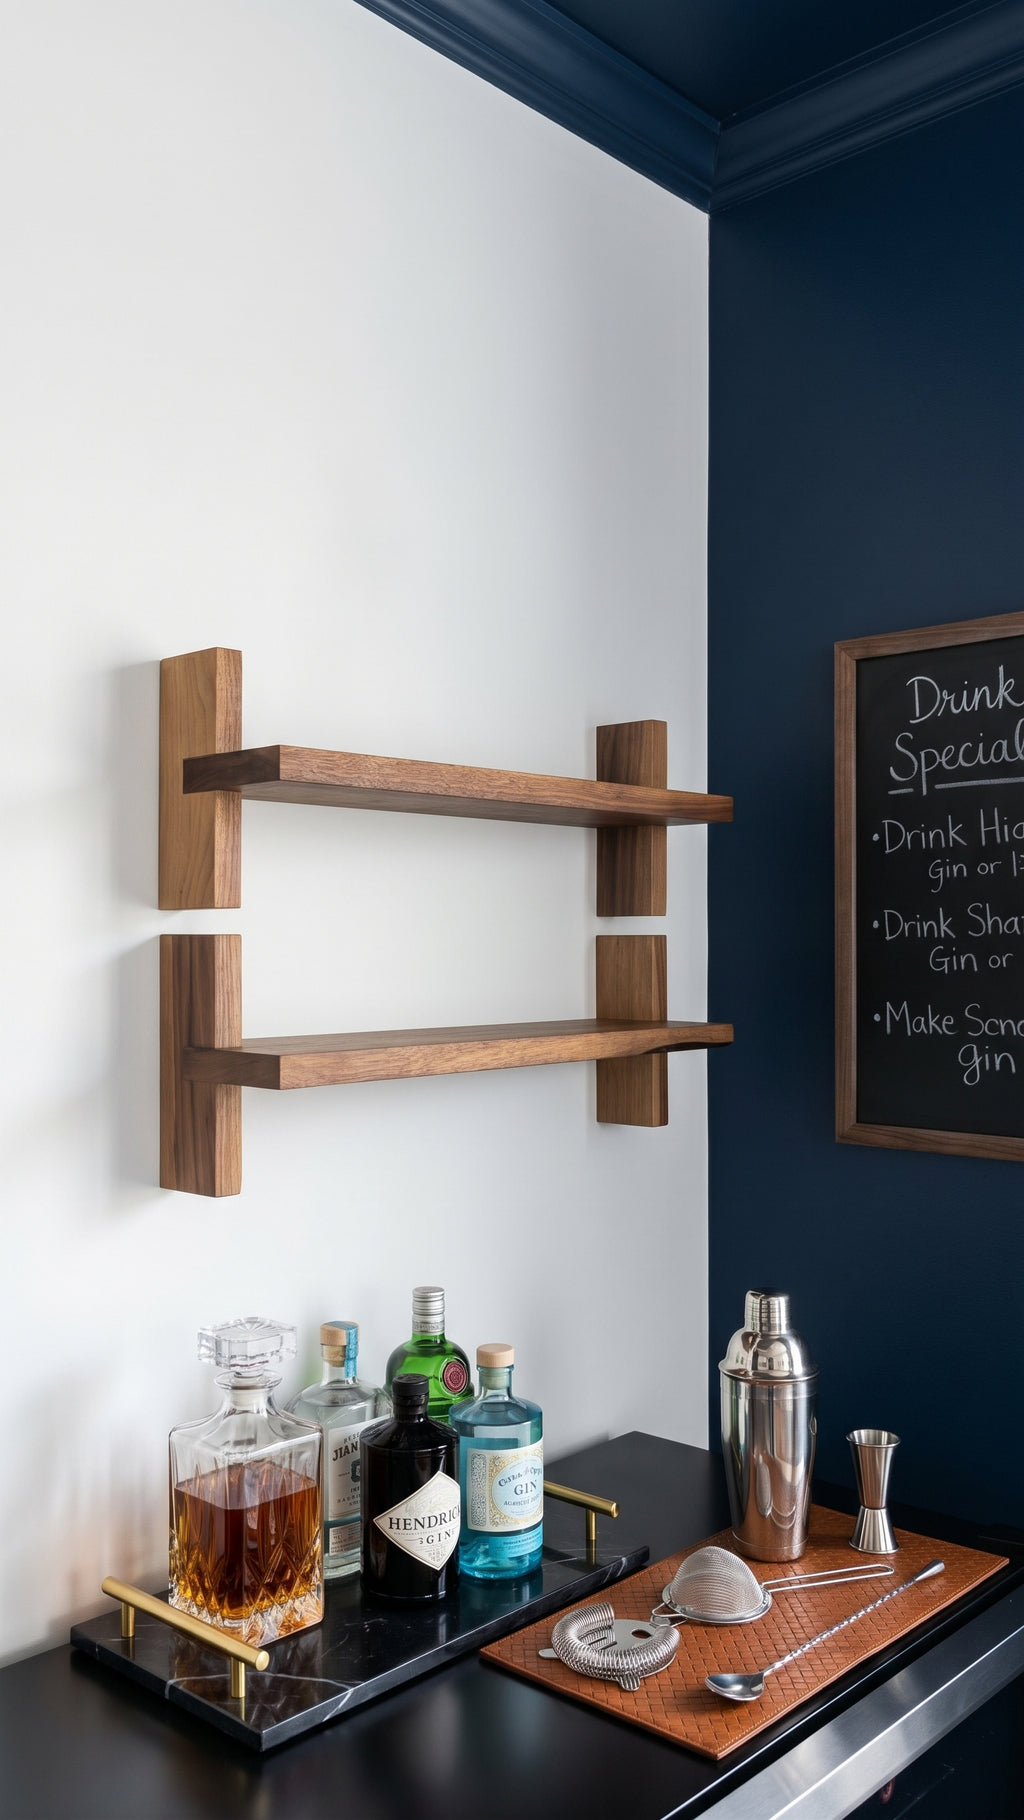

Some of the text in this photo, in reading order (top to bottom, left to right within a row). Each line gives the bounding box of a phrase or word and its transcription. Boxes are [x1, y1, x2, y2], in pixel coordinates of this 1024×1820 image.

[906, 664, 1024, 724] Drink
[881, 814, 968, 855] Drink
[977, 861, 1002, 875] or
[883, 902, 1024, 941] Drink Sha
[929, 945, 1014, 975] Gin or
[886, 1000, 959, 1037] Make
[958, 1043, 1016, 1086] gin
[513, 1479, 538, 1497] GIN
